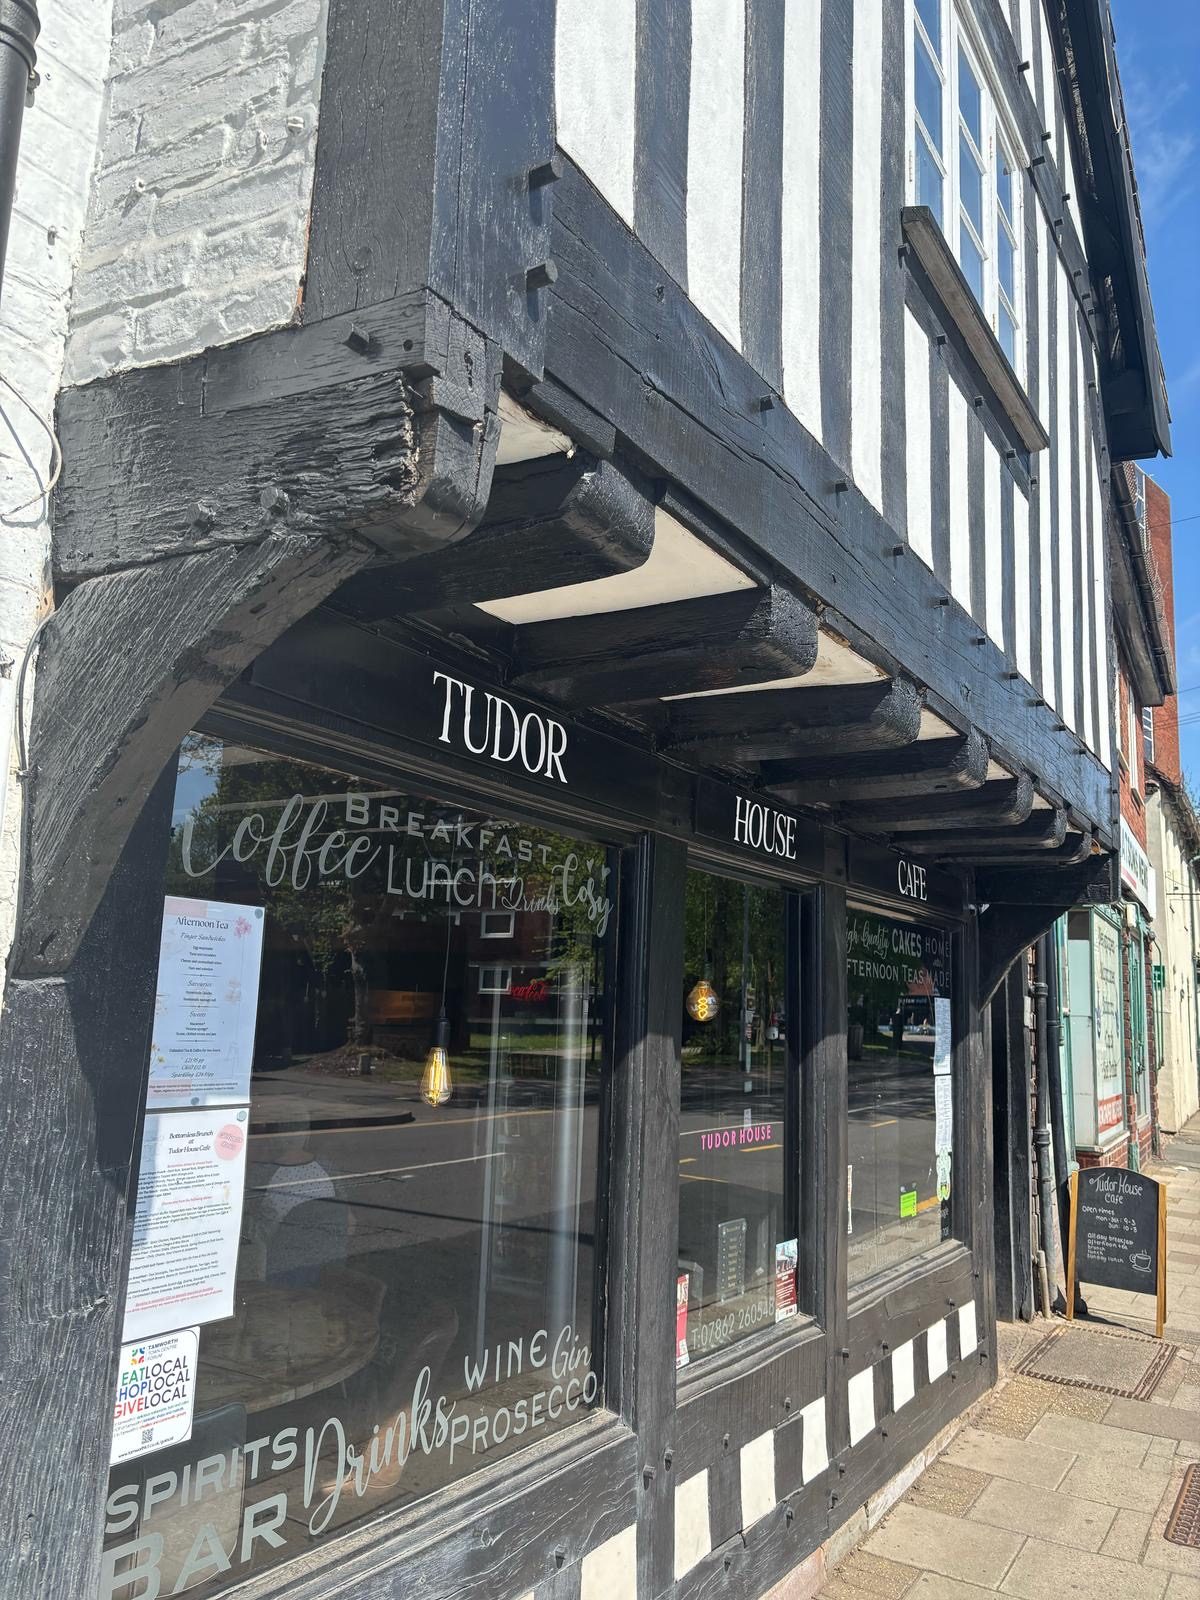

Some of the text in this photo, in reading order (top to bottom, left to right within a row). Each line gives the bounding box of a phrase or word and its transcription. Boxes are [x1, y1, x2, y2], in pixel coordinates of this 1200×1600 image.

[433, 670, 569, 784] TUDOR
[181, 793, 382, 891] Coffee
[345, 792, 552, 866] BREAKFAST
[733, 795, 798, 860] HOUSE
[502, 873, 561, 915] Drinks
[552, 853, 614, 937] Cosy
[897, 859, 928, 901] CAFE
[176, 916, 229, 929] Afternoon Tea
[892, 928, 922, 958] CAKES
[925, 937, 950, 958] HOME
[701, 1124, 771, 1150] TUDOR HOUSE
[1082, 1205, 1098, 1214] Open
[1089, 1172, 1143, 1196] Tudor House
[148, 1338, 178, 1350] TAMWORTH
[738, 1296, 775, 1329] 260548
[464, 1324, 593, 1391] WINE Gin
[450, 1371, 598, 1465] PROSECCO
[105, 1427, 298, 1533] SPIRITS
[303, 1366, 458, 1536] Drinks
[101, 1493, 287, 1600] BAR
